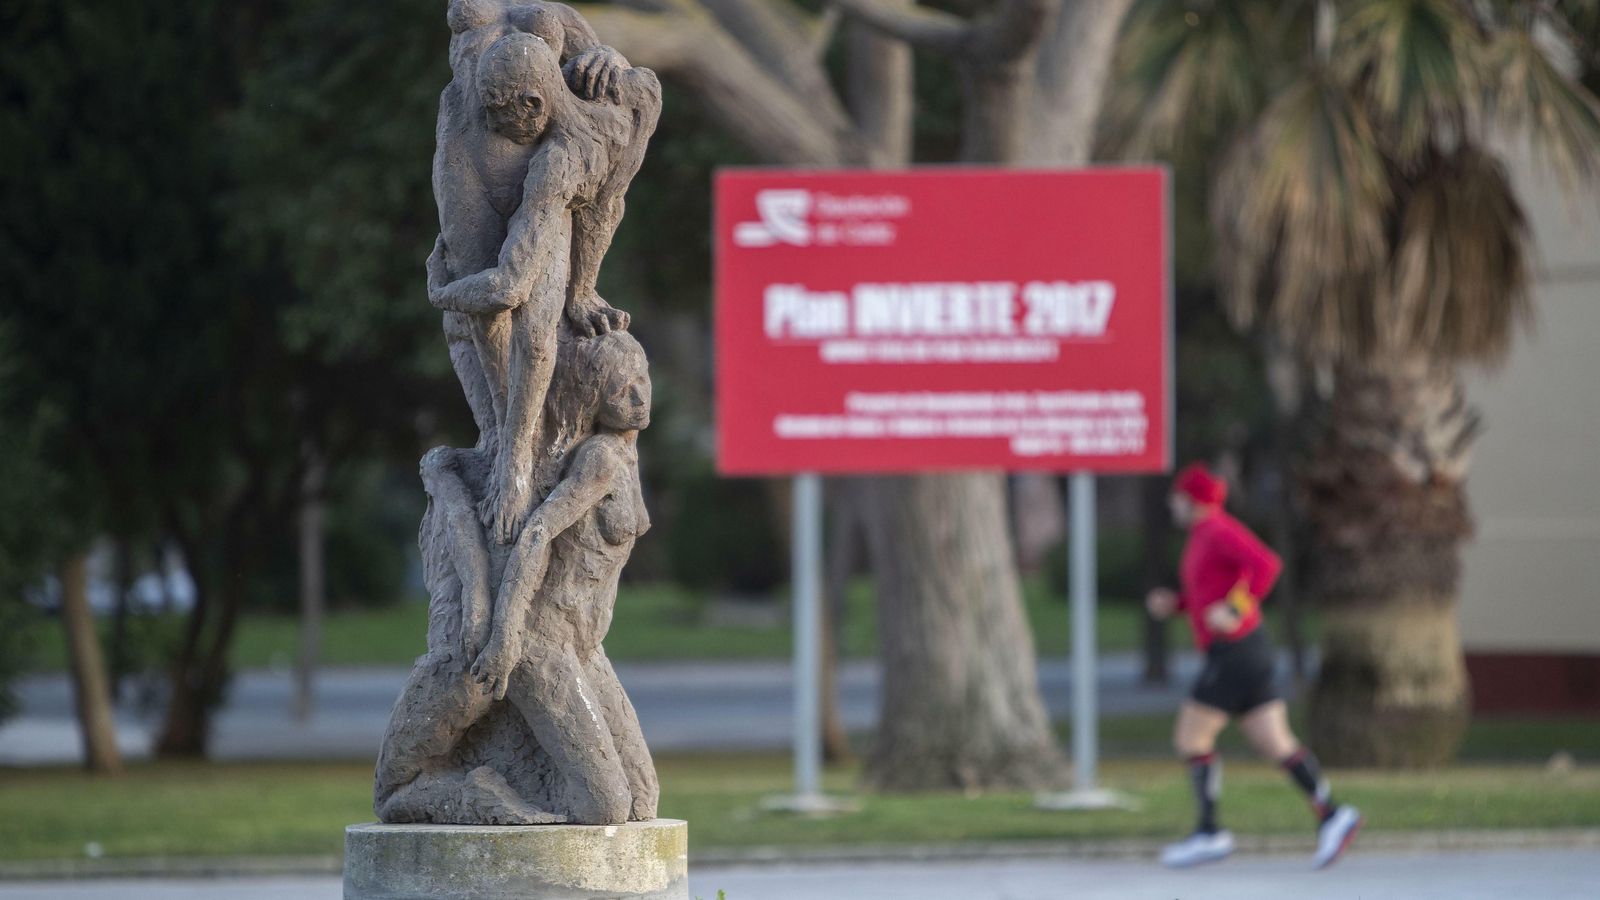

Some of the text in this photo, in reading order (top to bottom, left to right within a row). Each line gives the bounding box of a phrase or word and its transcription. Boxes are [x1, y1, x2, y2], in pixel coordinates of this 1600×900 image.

[764, 281, 1114, 338] Plan INVIERTE 2017
